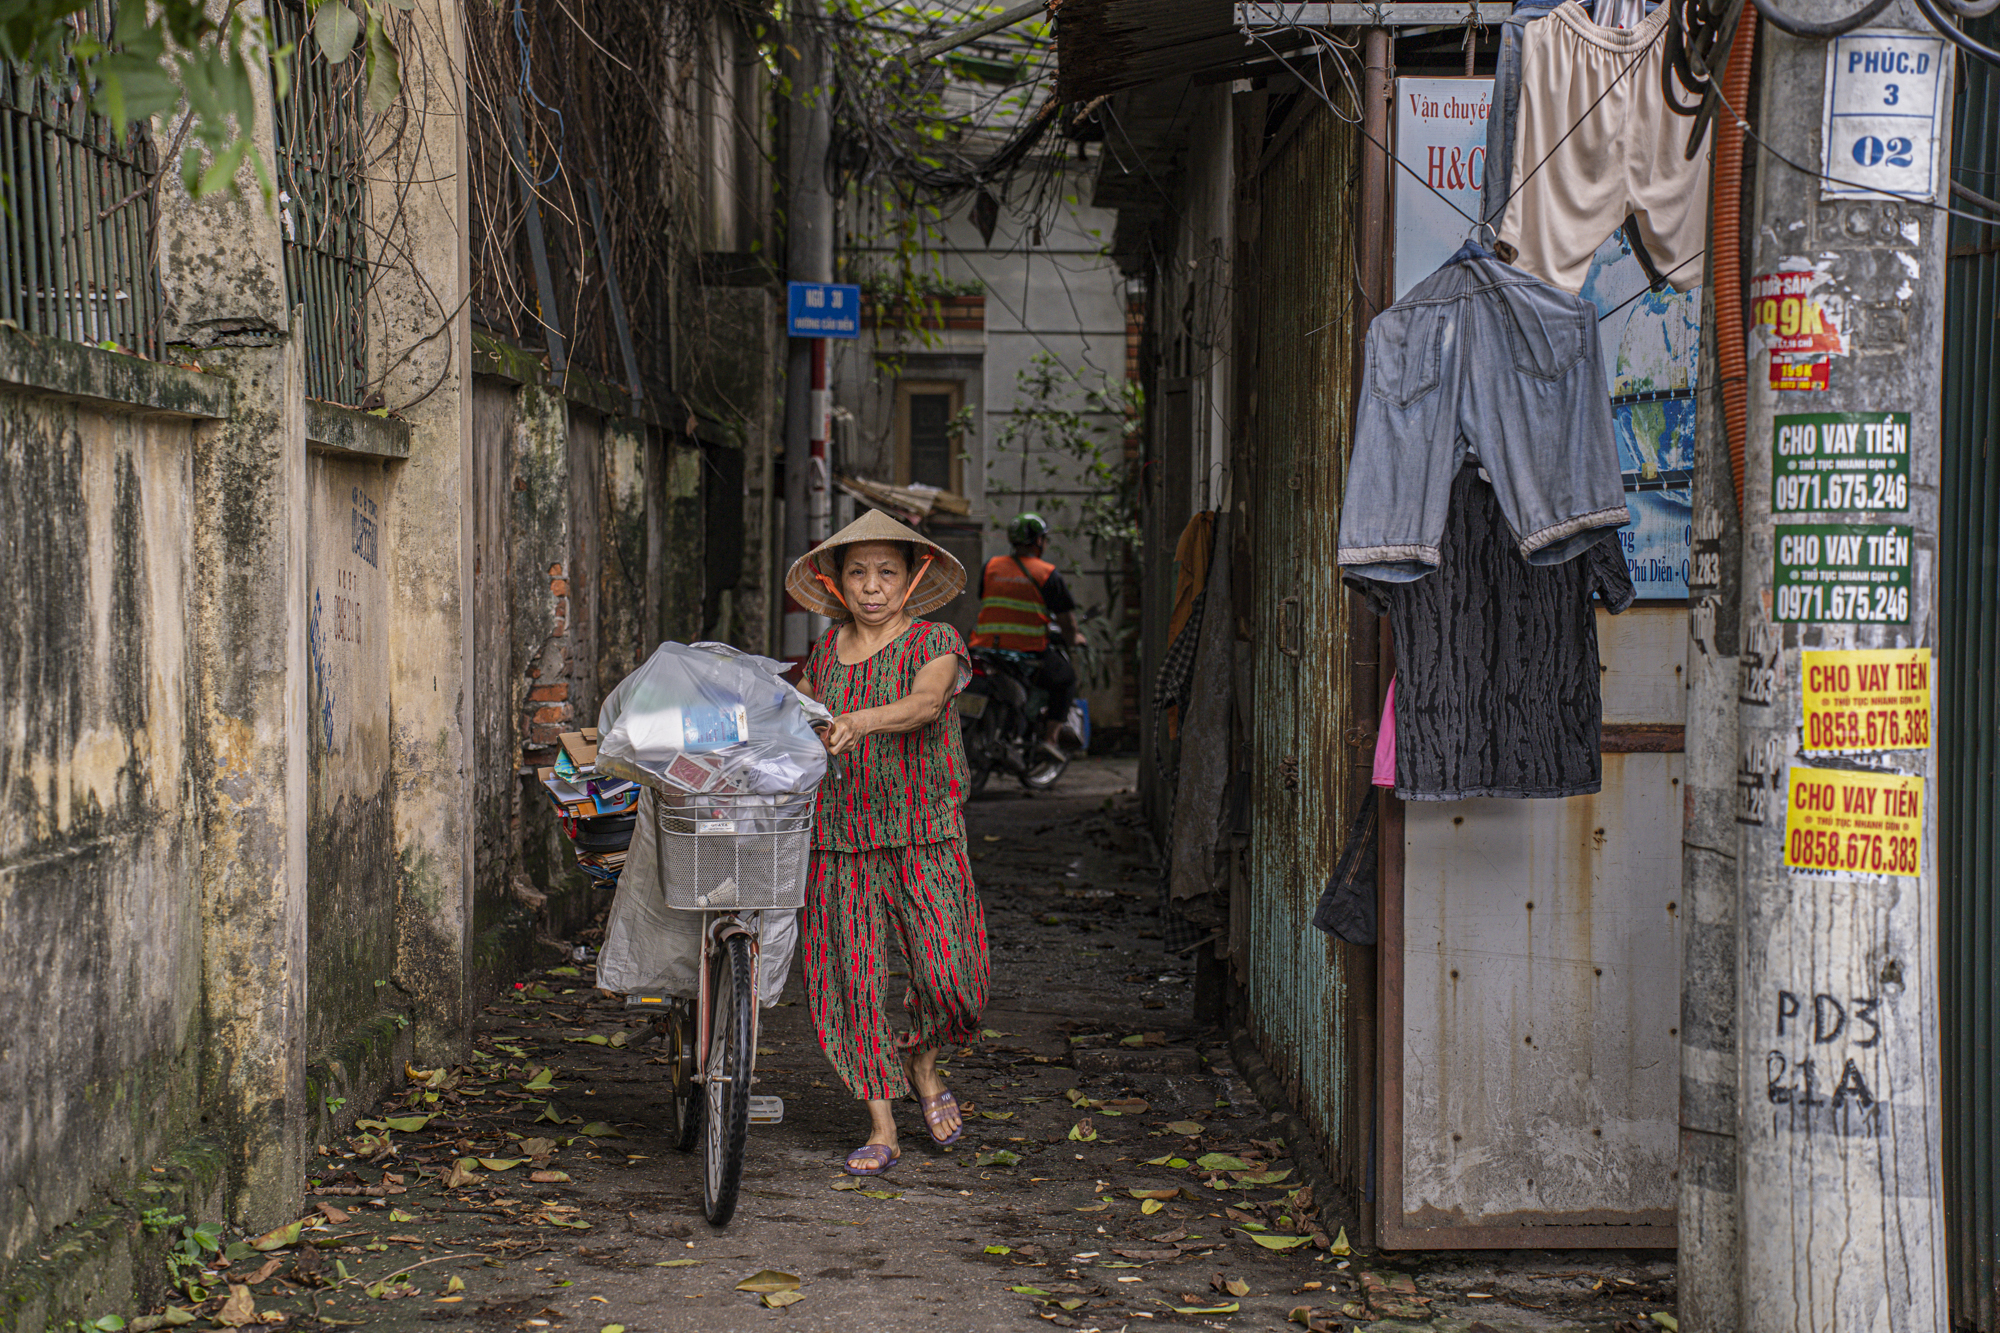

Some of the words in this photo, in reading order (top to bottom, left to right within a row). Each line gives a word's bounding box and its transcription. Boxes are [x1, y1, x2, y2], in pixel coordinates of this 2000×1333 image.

[1848, 47, 1930, 74] PHÚC.D
[1409, 93, 1439, 124] Vận
[1883, 84, 1899, 106] 3
[1852, 136, 1913, 168] 02
[1778, 424, 1817, 456] CHO
[1822, 423, 1860, 454] VAY
[1776, 473, 1907, 510] 0971.675.246
[1780, 534, 1820, 566] CHO
[1825, 534, 1863, 565] VAY
[1650, 555, 1673, 582] Diễn
[1777, 584, 1909, 622] 0971.675.246
[1810, 665, 1850, 693] CHO
[1857, 664, 1890, 692] VAY
[1810, 709, 1928, 748] 0858.676.383
[1795, 782, 1835, 812] CHO
[1843, 786, 1877, 815] VAY
[1791, 828, 1917, 873] 0858.676.383
[1777, 990, 1882, 1049] PD3
